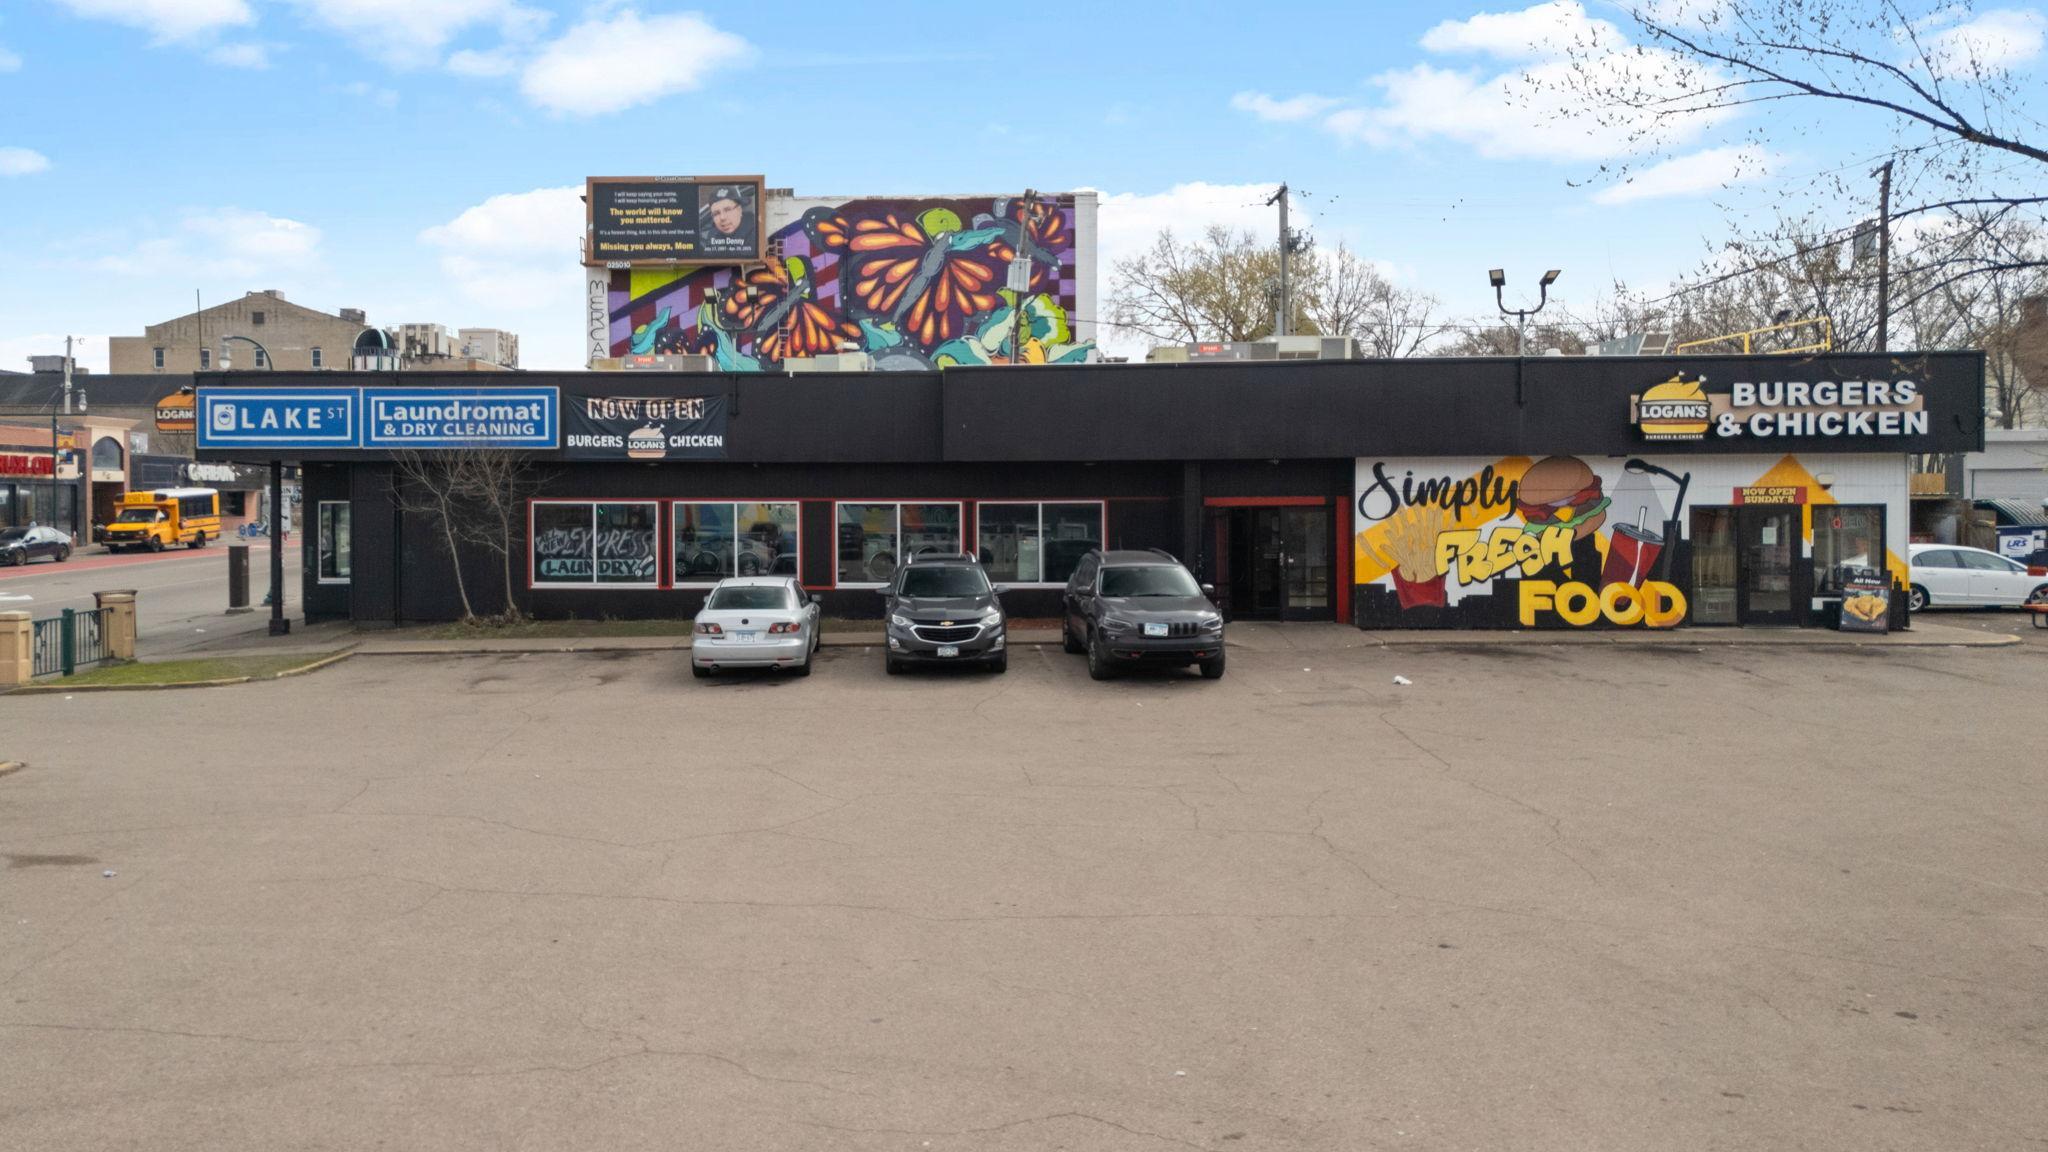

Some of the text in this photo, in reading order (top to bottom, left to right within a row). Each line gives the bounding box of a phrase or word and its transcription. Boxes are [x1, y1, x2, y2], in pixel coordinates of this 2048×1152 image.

[610, 207, 683, 216] The world will know
[620, 216, 672, 226] you mattered.
[600, 241, 694, 252] Missing you always, Mom
[711, 237, 744, 246] Evan Denny
[589, 279, 606, 358] MERCA
[1732, 380, 1917, 406] BURGERS
[241, 407, 345, 429] LAKE ST
[378, 401, 541, 421] Laundromat
[587, 397, 705, 421] NOW OPEN
[1641, 404, 1708, 420] LOGAN'S
[383, 422, 536, 436] & DRY CLEANING
[1716, 411, 1929, 437] & CHICKEN
[567, 434, 723, 450] BURGERS LOGAN'S CHICKEN
[1358, 461, 1519, 523] Simply
[1742, 487, 1797, 496] NOW OPEN
[1744, 495, 1795, 503] SUNDAY'S
[562, 527, 654, 557] EXPRESS
[1434, 526, 1577, 587] FRESH
[1518, 578, 1688, 628] FOOD
